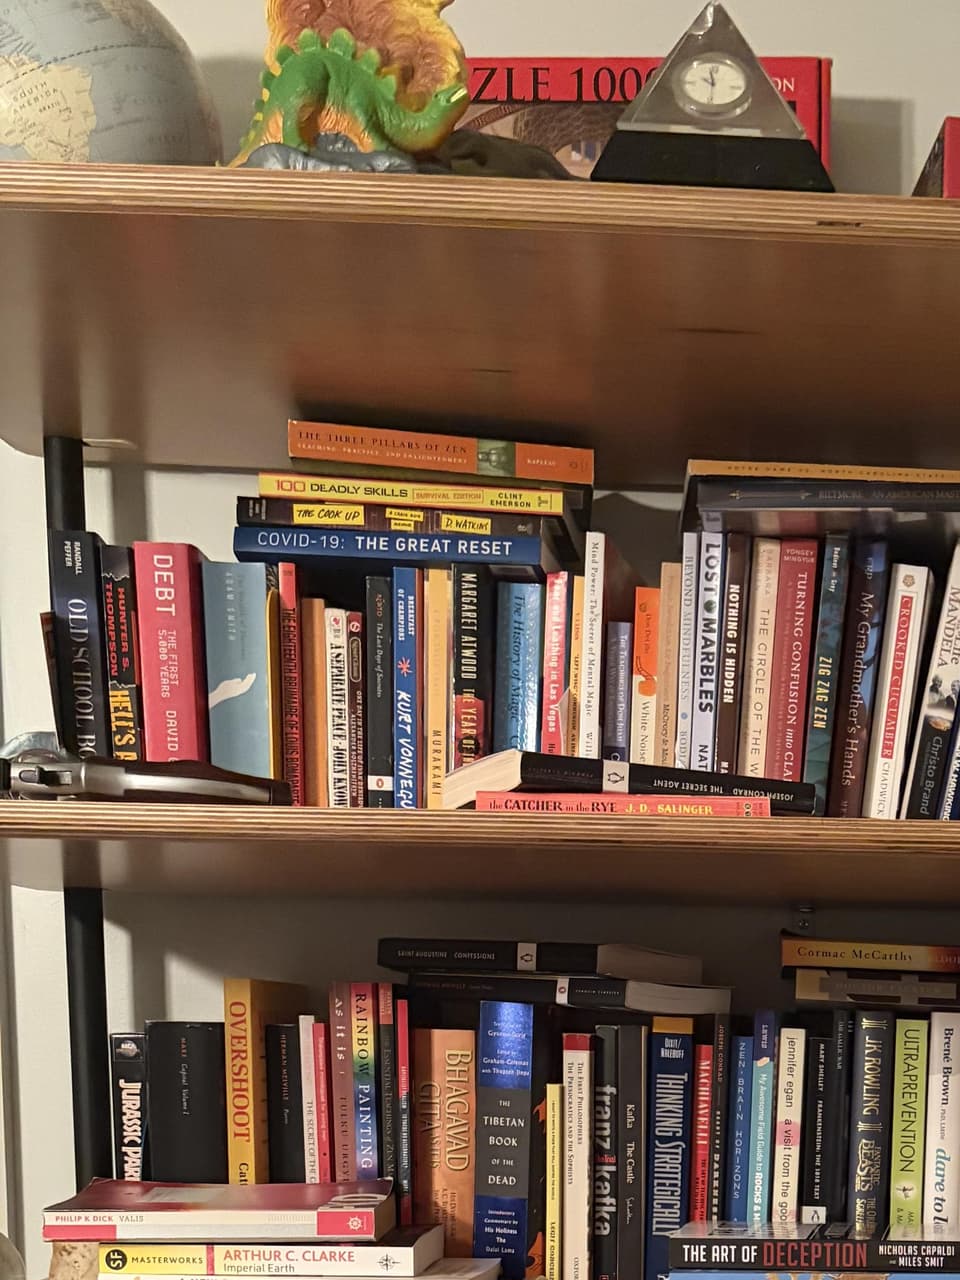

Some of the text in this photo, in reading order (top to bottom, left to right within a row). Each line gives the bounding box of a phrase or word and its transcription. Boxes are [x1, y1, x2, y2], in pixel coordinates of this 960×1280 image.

[13, 81, 47, 102] SOUTH
[472, 67, 550, 101] ZLE
[13, 88, 59, 114] AMERICA
[275, 480, 408, 498] 100 DEADLY SKILLS
[498, 492, 522, 501] CLINT
[297, 508, 360, 521] THE COOK UP
[490, 499, 531, 507] EMERSON
[258, 532, 512, 555] COVID-19: THE GREAT RESET
[153, 554, 176, 616] DEBT
[461, 573, 478, 679] MARGARET ATWOOD
[698, 544, 721, 713] LOST MARBLES
[722, 584, 740, 703] NOTHING IS HIDDEN
[168, 630, 178, 686] THE FIRST
[160, 667, 169, 698] YEARS
[489, 799, 616, 813] the CATCHER in the RYE
[626, 803, 712, 814] J. D. SALINGER
[228, 1000, 250, 1143] OVERSHOOT
[445, 1048, 472, 1172] BHAGAVAD
[899, 1029, 920, 1173] ULTRAPREVENTION
[131, 1256, 203, 1264] MASTERWORKS
[223, 1249, 355, 1262] ARTHUR C. CLARKE
[683, 1243, 867, 1267] THE ART OF DECEPTION
